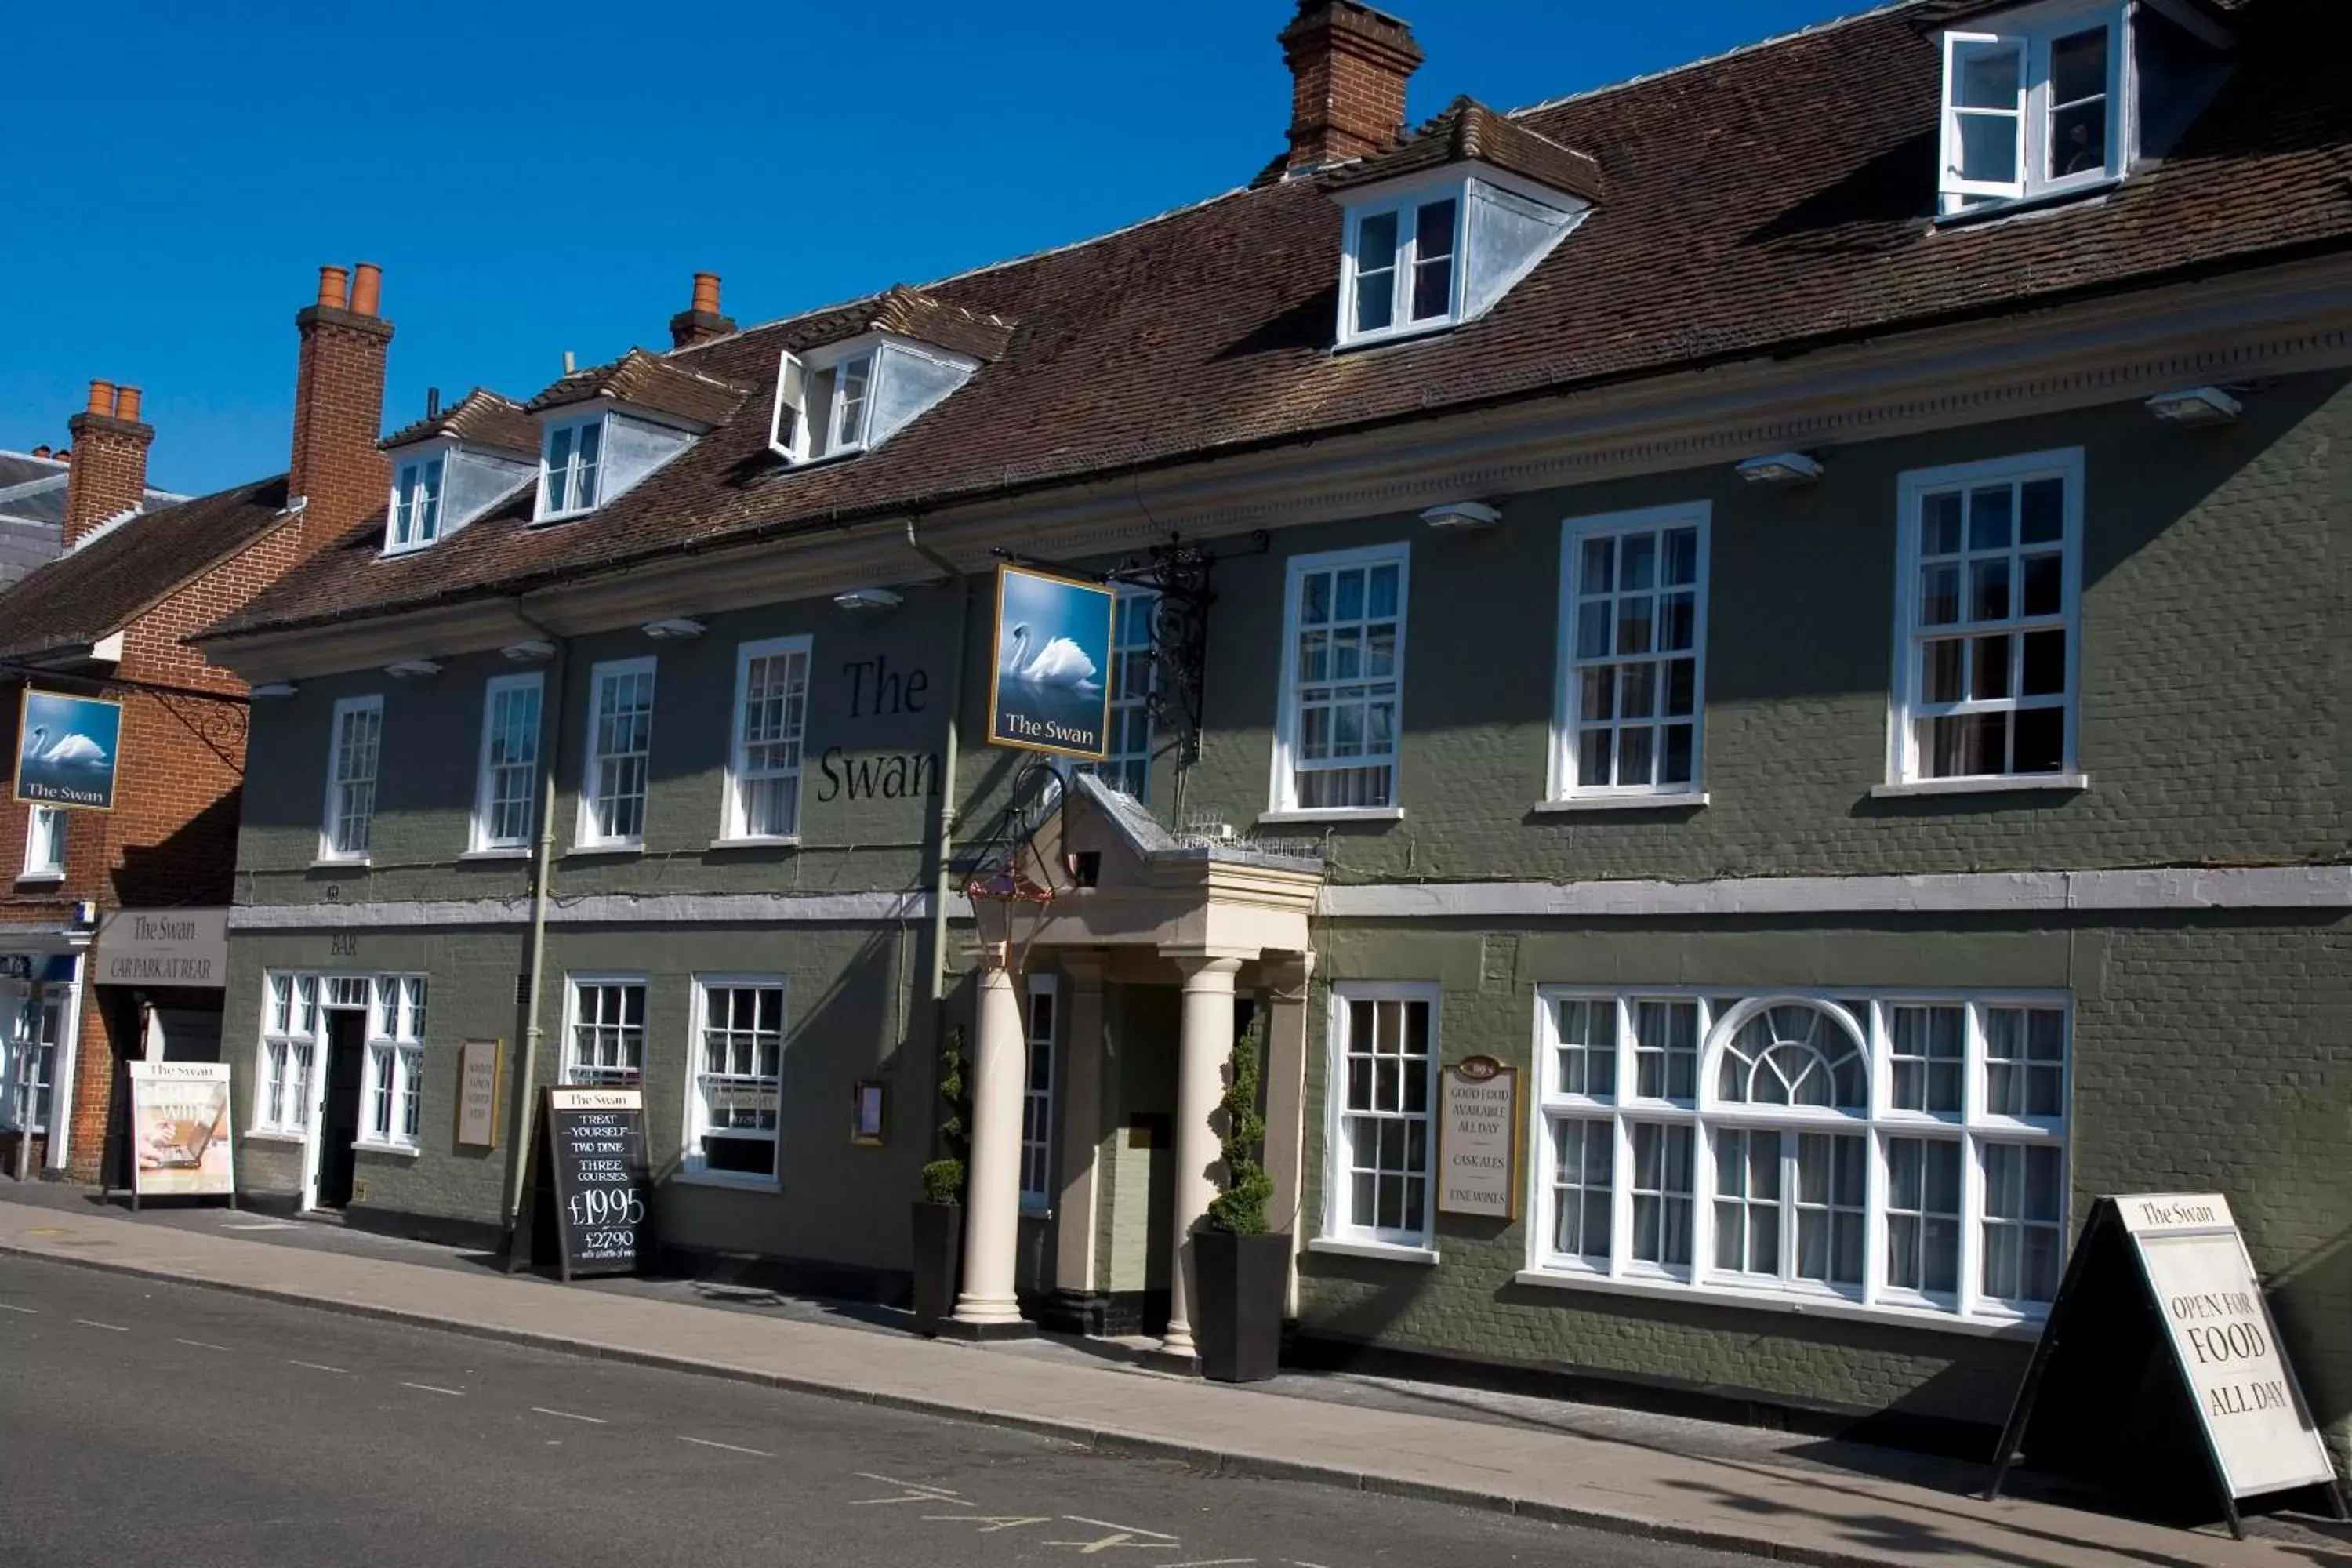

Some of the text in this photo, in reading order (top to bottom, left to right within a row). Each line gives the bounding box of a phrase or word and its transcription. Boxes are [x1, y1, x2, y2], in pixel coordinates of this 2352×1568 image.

[844, 654, 928, 719] The
[1005, 713, 1094, 745] The Swan
[818, 746, 941, 802] Swan
[27, 783, 103, 804] The Swan
[133, 916, 195, 940] The Swan
[111, 957, 211, 979] CAR PARK AT REAR
[570, 1093, 626, 1105] The Swan
[1451, 1087, 1509, 1100] GOOD FOOD
[1454, 1104, 1505, 1117] AVAILABLE
[578, 1115, 618, 1125] TREAT
[1458, 1121, 1500, 1135] ALL DAY
[570, 1127, 628, 1137] YOURSELF
[571, 1142, 625, 1152] TWO DINE
[578, 1160, 623, 1171] THREE
[1453, 1154, 1504, 1168] CASK ALES
[577, 1172, 629, 1181] COURSES
[1450, 1189, 1506, 1204] FINE WINES
[568, 1188, 645, 1225] £19.95
[2139, 1202, 2216, 1225] The Swan
[2172, 1293, 2255, 1319] OPEN FOR
[2187, 1323, 2265, 1363] FOOD
[2210, 1381, 2287, 1416] ALL DAY
